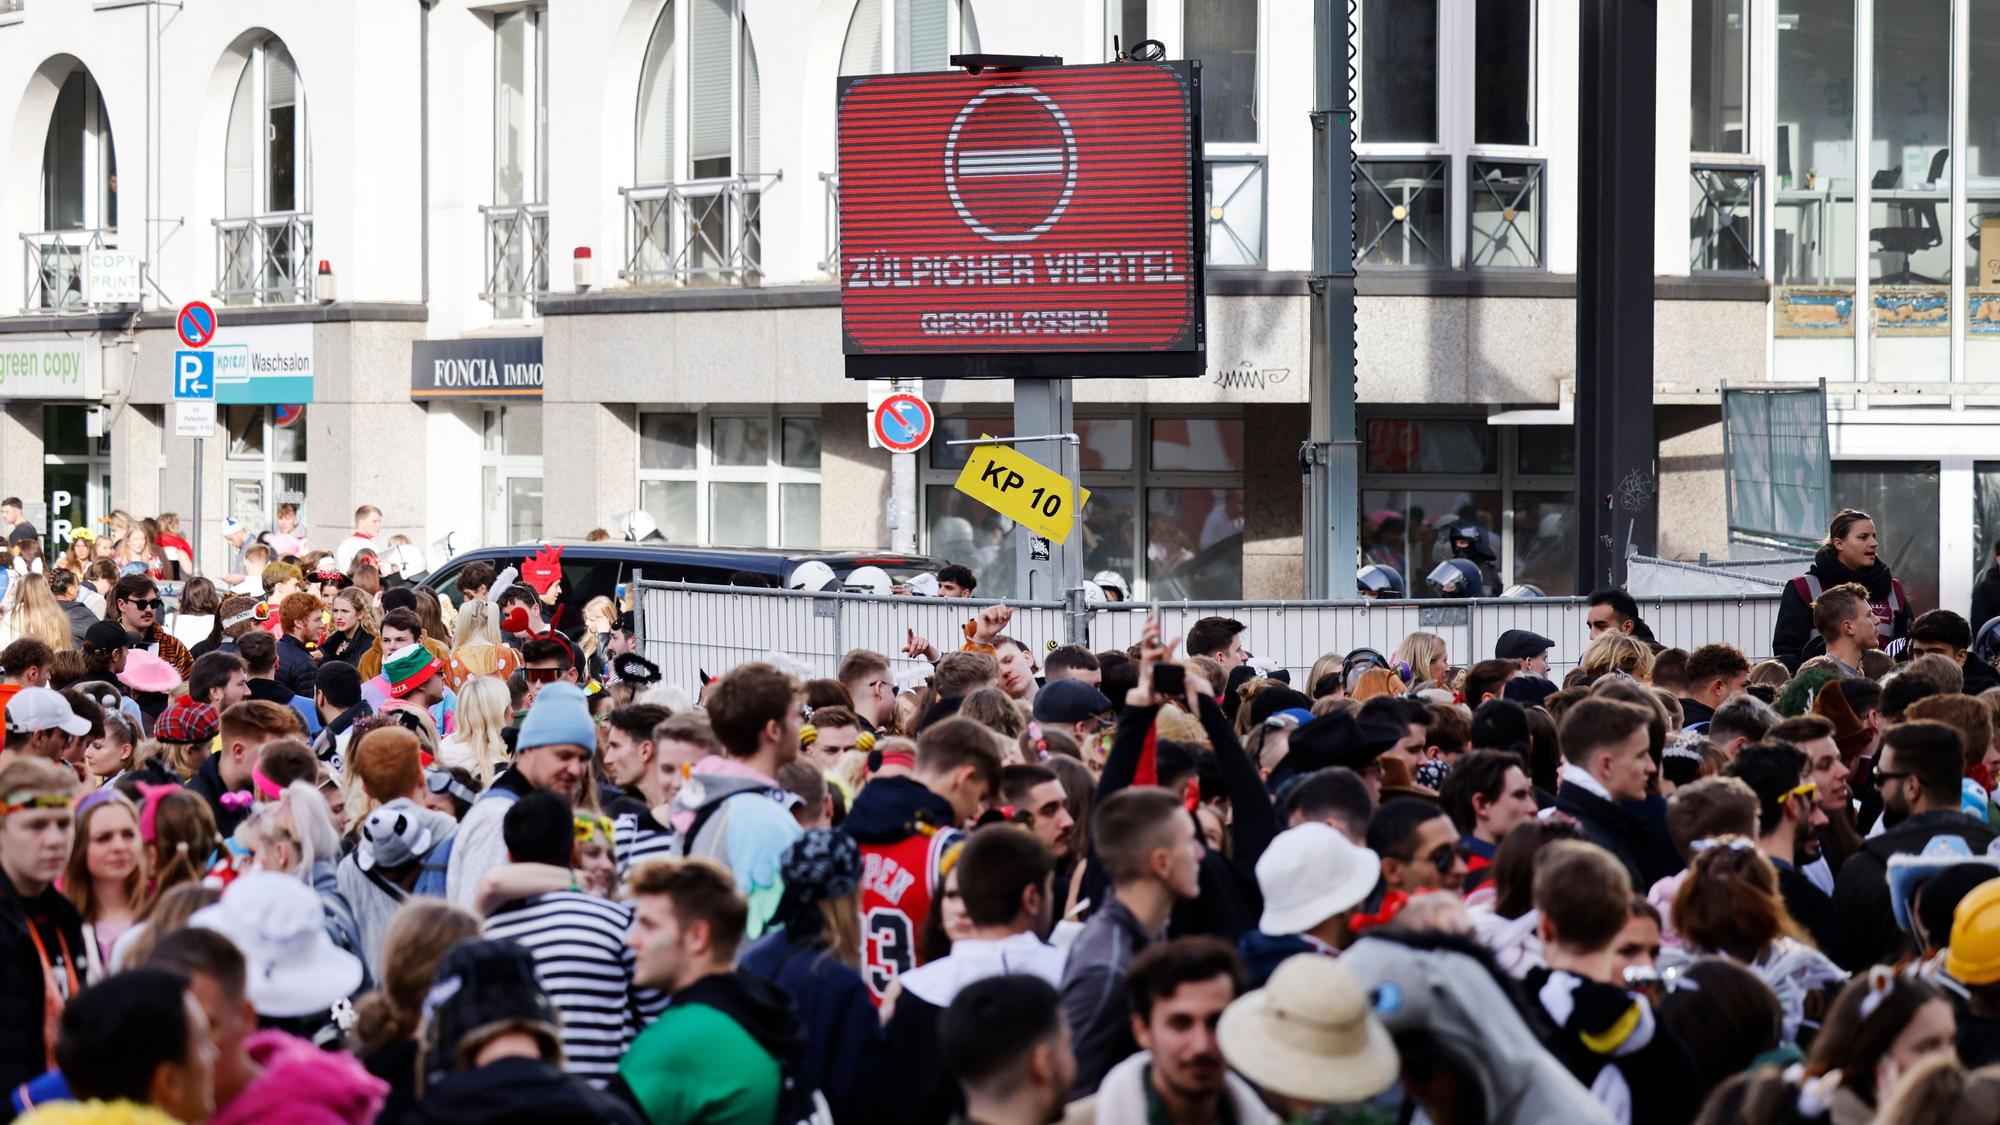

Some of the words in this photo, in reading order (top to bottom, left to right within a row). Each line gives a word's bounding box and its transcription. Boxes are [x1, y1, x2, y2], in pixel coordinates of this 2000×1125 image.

[91, 255, 136, 268] COPY
[848, 249, 1034, 288] ZÜLPICHER
[1043, 250, 1185, 284] VIERTEL
[91, 275, 136, 289] PRINT
[921, 310, 1108, 335] GESCHLOSSEN
[43, 352, 80, 384] copy
[180, 355, 203, 393] P
[216, 354, 246, 373] xpress
[252, 353, 310, 371] Waschsalon
[434, 359, 499, 387] FONCIA
[980, 459, 1025, 493] KP
[1030, 487, 1061, 517] 10
[863, 853, 916, 906] PEN
